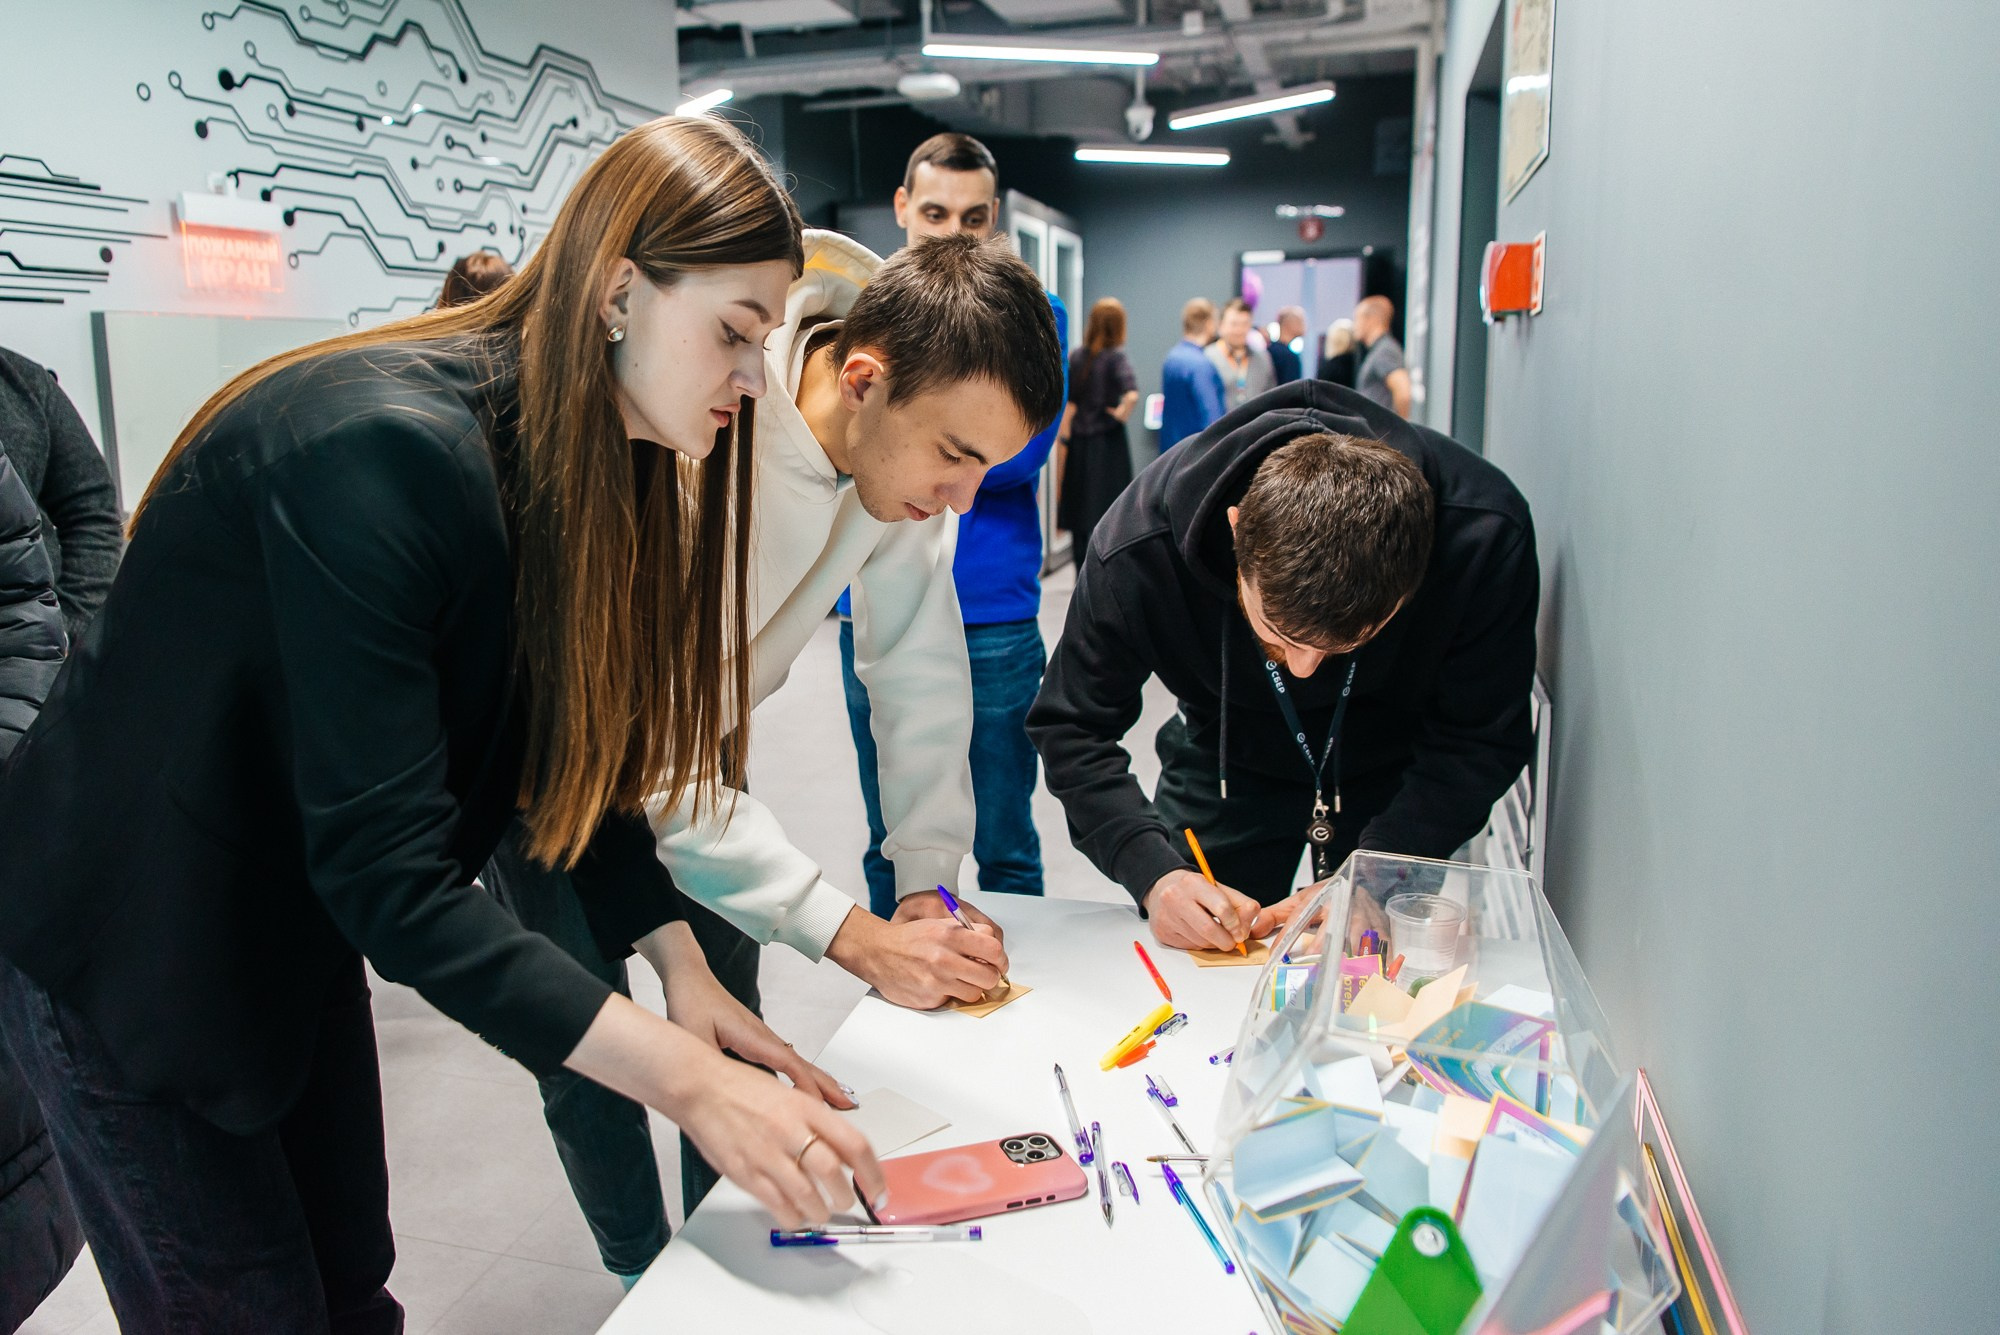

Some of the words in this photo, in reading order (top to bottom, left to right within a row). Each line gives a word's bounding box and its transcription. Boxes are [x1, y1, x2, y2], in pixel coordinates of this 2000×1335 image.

[187, 234, 279, 263] ПОЖАРНЫЙ
[201, 257, 270, 287] КРАН
[1271, 670, 1286, 694] СБЕР
